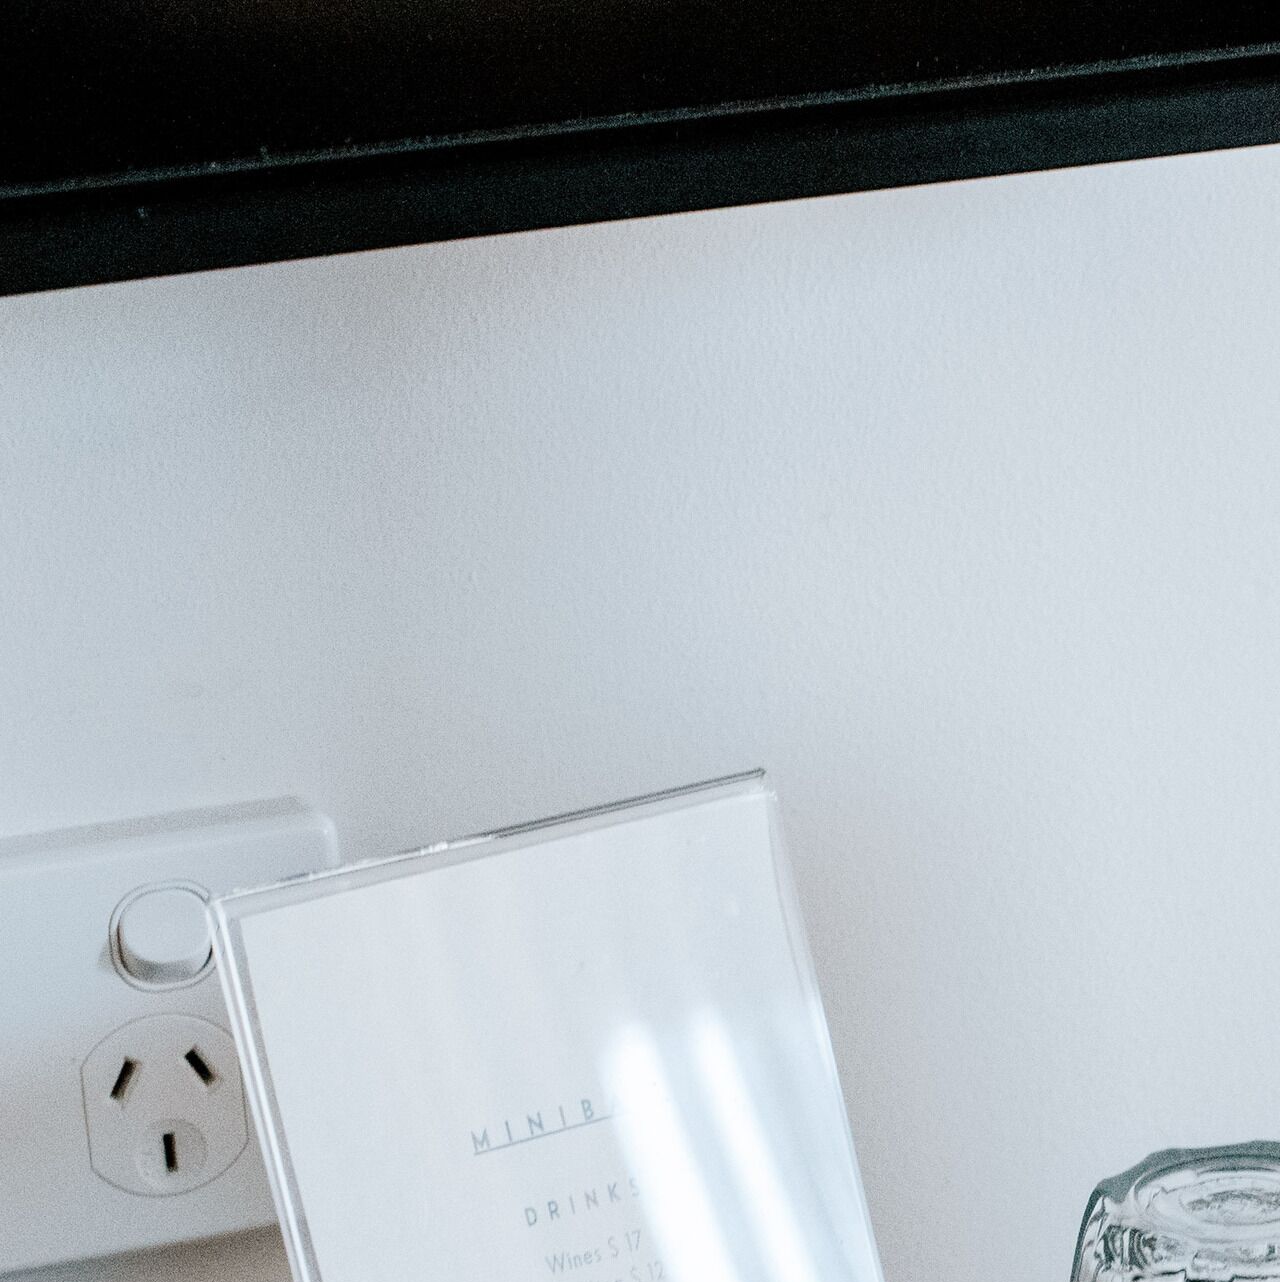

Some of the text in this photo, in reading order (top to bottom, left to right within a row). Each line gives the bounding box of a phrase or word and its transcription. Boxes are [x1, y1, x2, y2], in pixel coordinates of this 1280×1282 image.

[471, 1099, 596, 1152] MINIB
[524, 1178, 640, 1227] DRINKS
[545, 1246, 602, 1275] Wines
[624, 1229, 642, 1252] 17
[647, 1261, 667, 1282] 12
